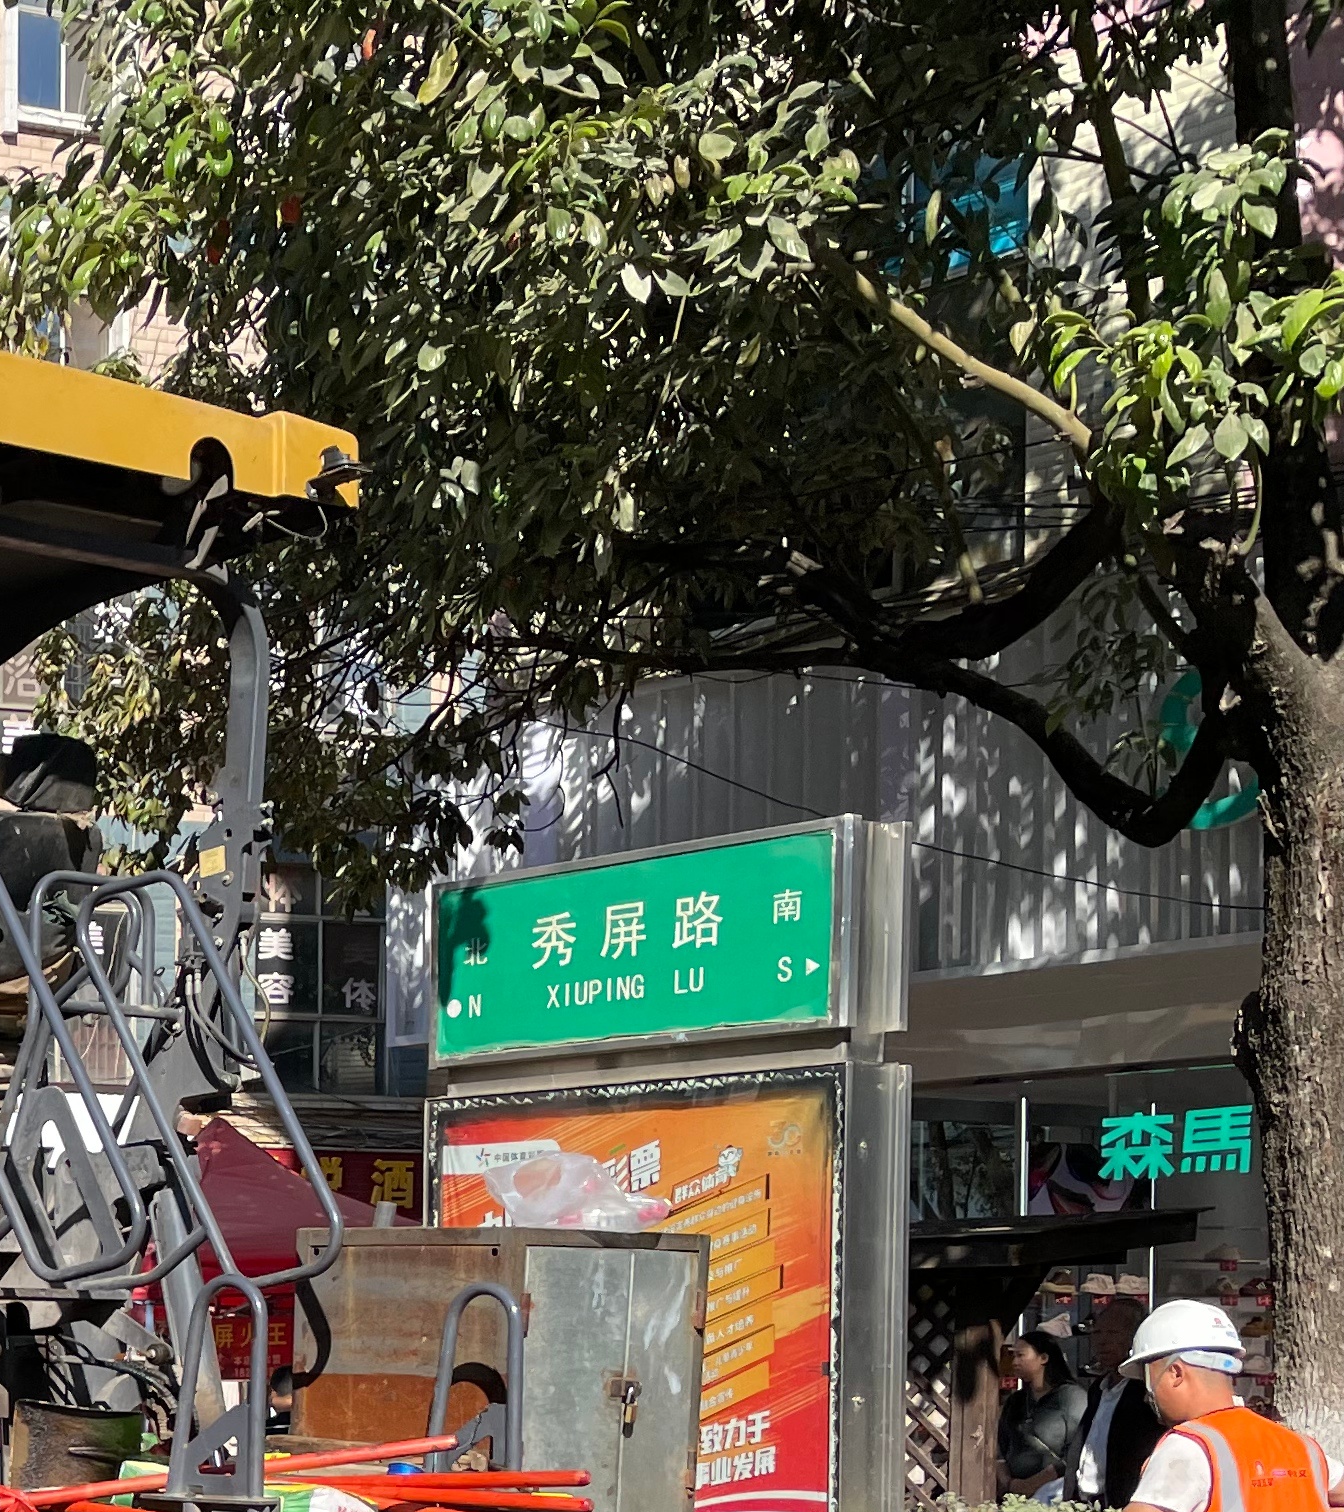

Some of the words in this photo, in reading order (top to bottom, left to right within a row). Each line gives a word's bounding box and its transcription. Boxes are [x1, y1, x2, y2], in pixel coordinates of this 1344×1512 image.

[771, 888, 804, 925] 南
[463, 937, 489, 967] 北
[530, 890, 724, 971] 秀屏路
[257, 927, 295, 1005] 美容
[545, 973, 646, 1010] XIUPING
[673, 966, 705, 996] LU
[777, 955, 793, 983] S
[468, 994, 482, 1019] N
[1098, 1104, 1254, 1181] 森馬
[700, 1410, 771, 1455] 致力于
